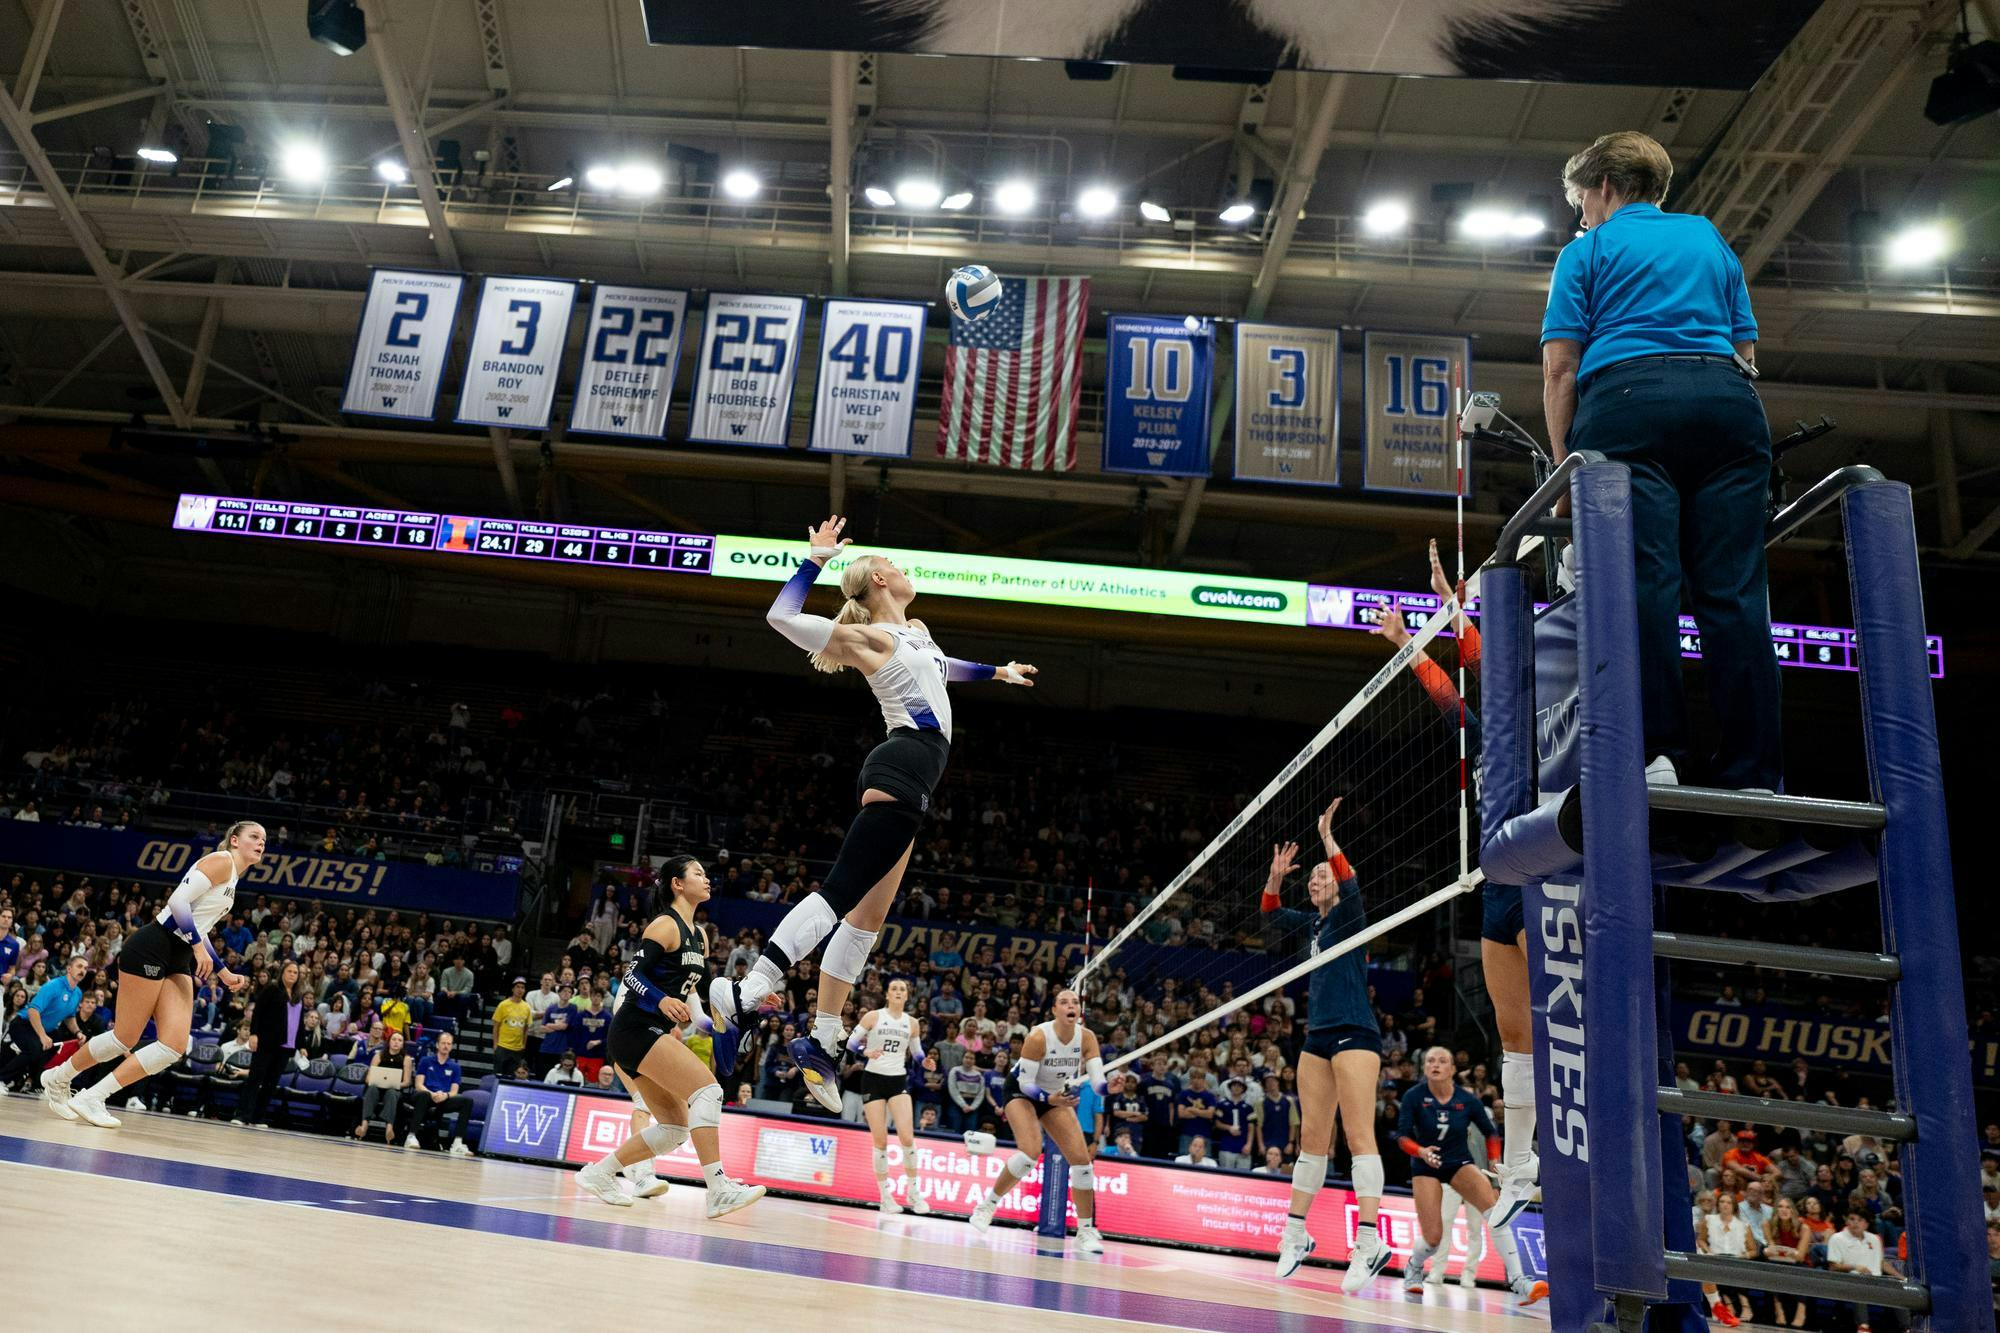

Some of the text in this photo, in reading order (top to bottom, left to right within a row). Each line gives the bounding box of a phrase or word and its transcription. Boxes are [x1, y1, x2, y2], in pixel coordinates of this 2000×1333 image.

[386, 291, 429, 348] 2
[499, 299, 541, 356] 3
[592, 306, 675, 367] 22
[709, 313, 789, 374] 25
[378, 352, 420, 366] ISAIAH
[829, 323, 914, 384] 40
[369, 366, 422, 382] THOMAS
[482, 360, 545, 376] BRANDON
[1127, 337, 1194, 403] 10
[497, 377, 523, 389] ROY
[605, 370, 650, 385] DETLEF
[731, 379, 758, 392] BOB
[1267, 346, 1307, 410] 3
[591, 385, 659, 401] SCHREMPF
[831, 386, 900, 402] CHRISTIAN
[1384, 354, 1450, 420] 16
[708, 393, 777, 410] HOUBREGS
[846, 403, 883, 416] WELP
[1133, 404, 1184, 421] KELSEY
[1251, 412, 1322, 429] COURTNEY
[1138, 420, 1177, 435] PLUM
[1392, 422, 1442, 438] KRISTA
[1133, 437, 1182, 451] 2013-2017
[1249, 429, 1327, 446] THOMPSON
[254, 502, 286, 513] KILLS
[218, 514, 426, 543] 11.1 19 41 5 3 18
[483, 521, 514, 531] ATK%
[521, 524, 554, 535] KILLS
[481, 535, 702, 567] 24.1 29 44 5 1 27
[914, 567, 987, 585] Screening
[992, 573, 1047, 588] Partner
[1051, 580, 1065, 590] of
[1070, 580, 1095, 592] UW
[1100, 582, 1167, 598] Athletics
[1199, 590, 1280, 608] evolv.com
[1399, 596, 1436, 607] KILLS
[1407, 612, 1428, 627] 19
[1806, 630, 1841, 641] BLKS
[1819, 647, 1831, 662] 5
[137, 840, 192, 873] GO
[1687, 1010, 1750, 1048] GO
[883, 1039, 900, 1053] 22
[501, 1101, 559, 1146] W
[1436, 1123, 1450, 1141] 7
[810, 1138, 833, 1155] W
[886, 1144, 980, 1177] Oficial
[917, 1176, 961, 1201] UW
[1172, 1184, 1242, 1201] Membership
[1197, 1203, 1261, 1219] restrictions
[1202, 1217, 1246, 1232] Insured
[1246, 1223, 1261, 1235] by
